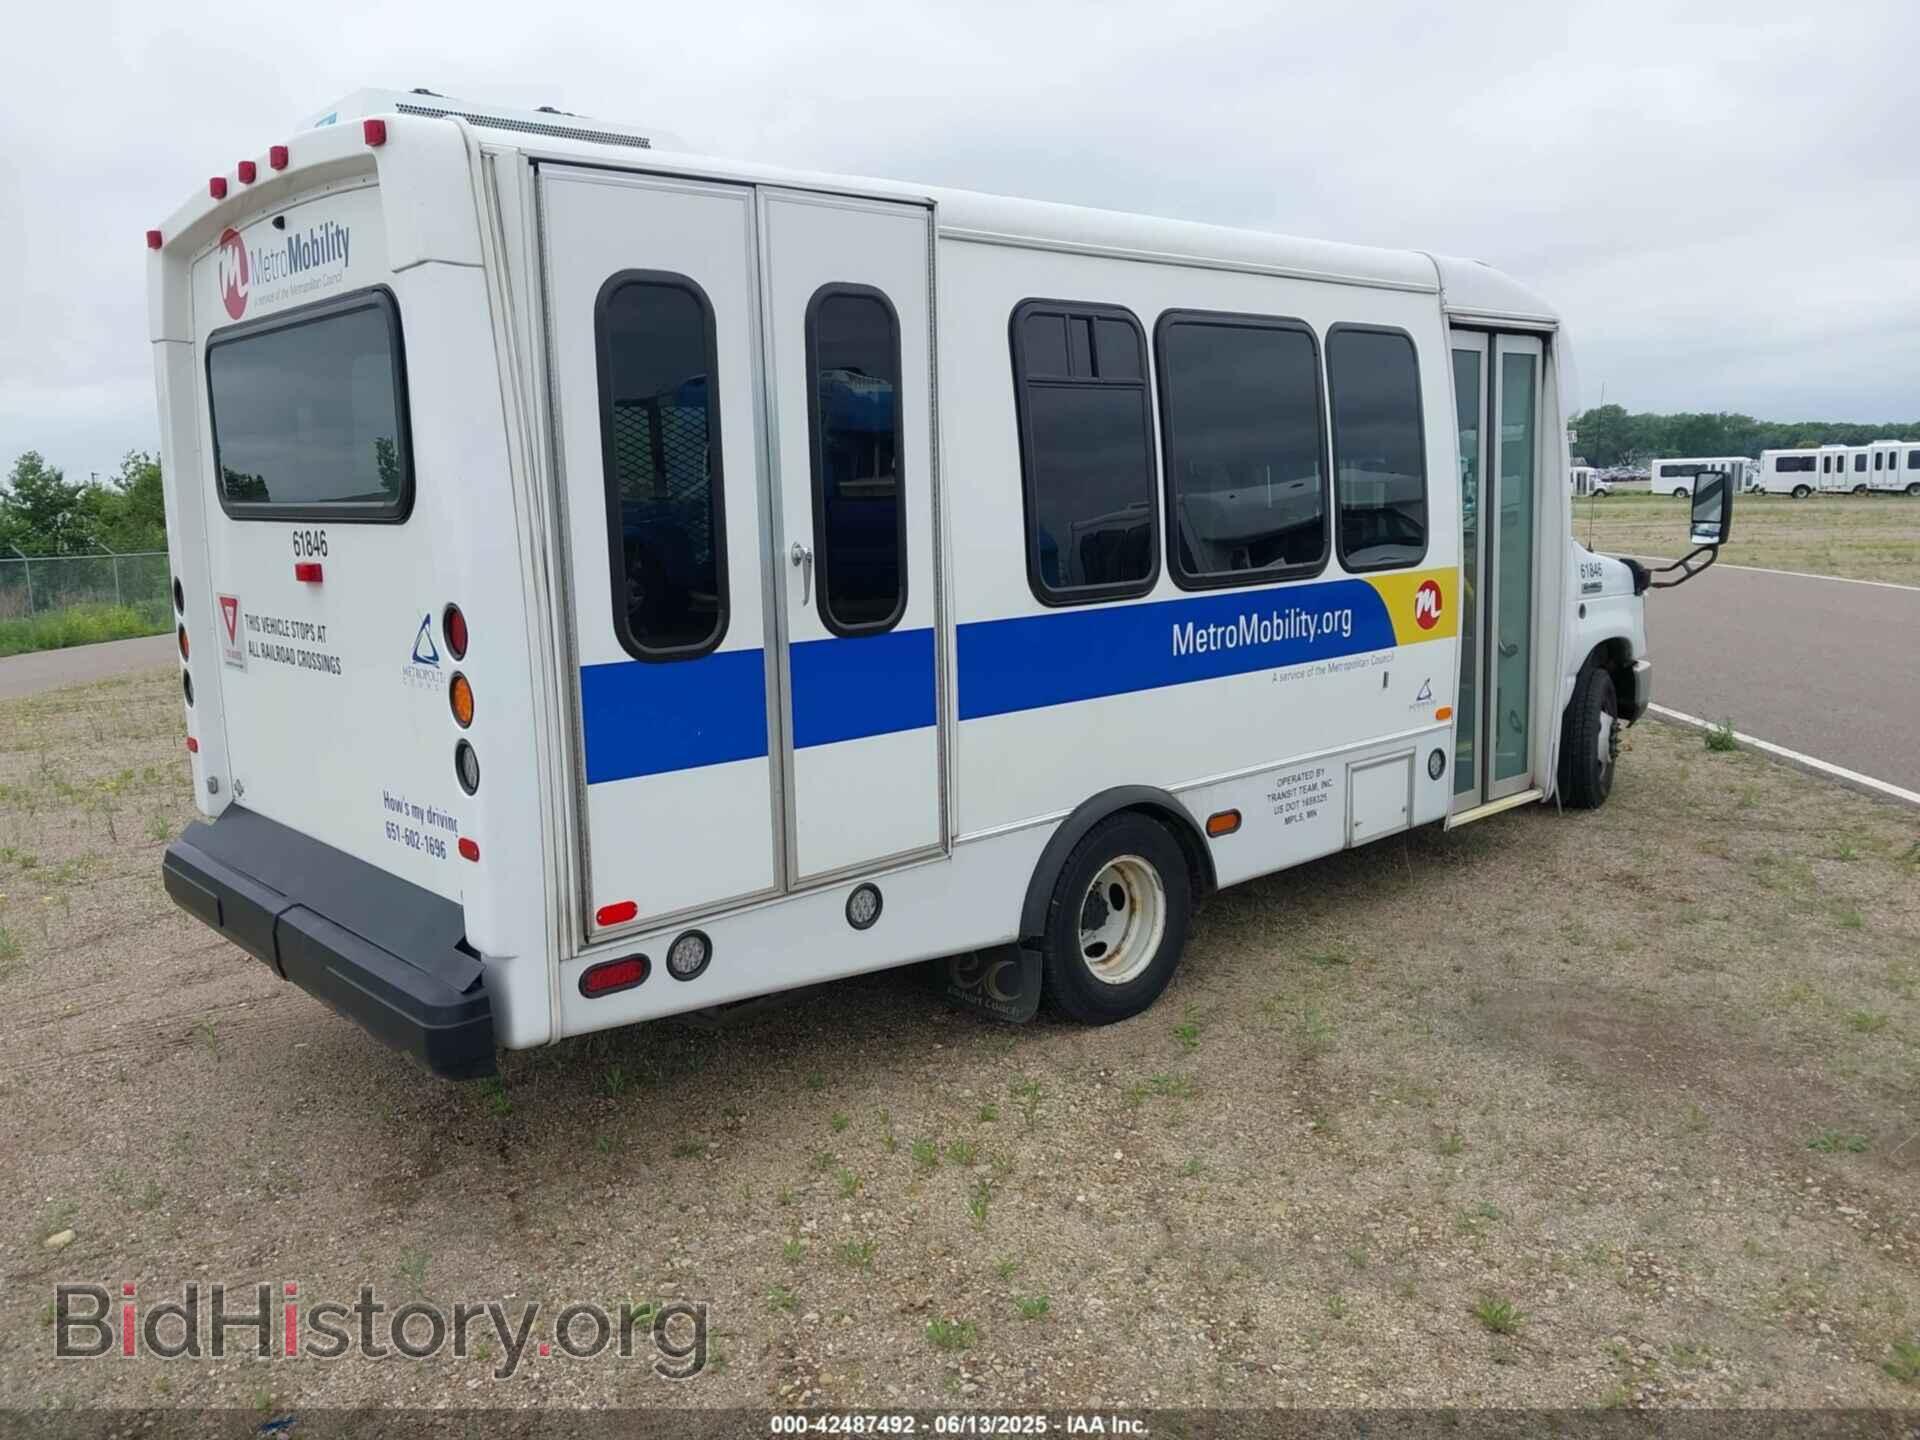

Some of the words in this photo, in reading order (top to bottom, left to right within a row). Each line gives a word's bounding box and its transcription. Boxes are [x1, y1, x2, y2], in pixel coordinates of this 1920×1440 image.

[250, 220, 349, 284] MetroMobility
[292, 529, 328, 557] 61846
[1580, 562, 1603, 579] 61846
[245, 613, 261, 632] THIS
[261, 616, 290, 638] VEHICLE
[291, 620, 316, 642] STOPS
[317, 624, 327, 643] AT
[1172, 607, 1352, 656] MetroMobility.org
[248, 640, 261, 658] ALL
[261, 642, 296, 666] RAILROAD
[297, 648, 342, 675] CROSSINGS
[1279, 669, 1305, 682] service
[1307, 666, 1314, 677] of
[1315, 665, 1327, 676] the
[1328, 656, 1370, 673] Metropolitan
[1371, 651, 1394, 666] Council
[1277, 769, 1314, 788] OPERATED
[1315, 768, 1325, 778] BY
[383, 789, 410, 816] How's
[411, 804, 425, 825] my
[1267, 787, 1297, 803] TRANSIT
[1273, 804, 1284, 816] US
[1285, 800, 1299, 812] DOT
[386, 821, 447, 860] 651-602-1696
